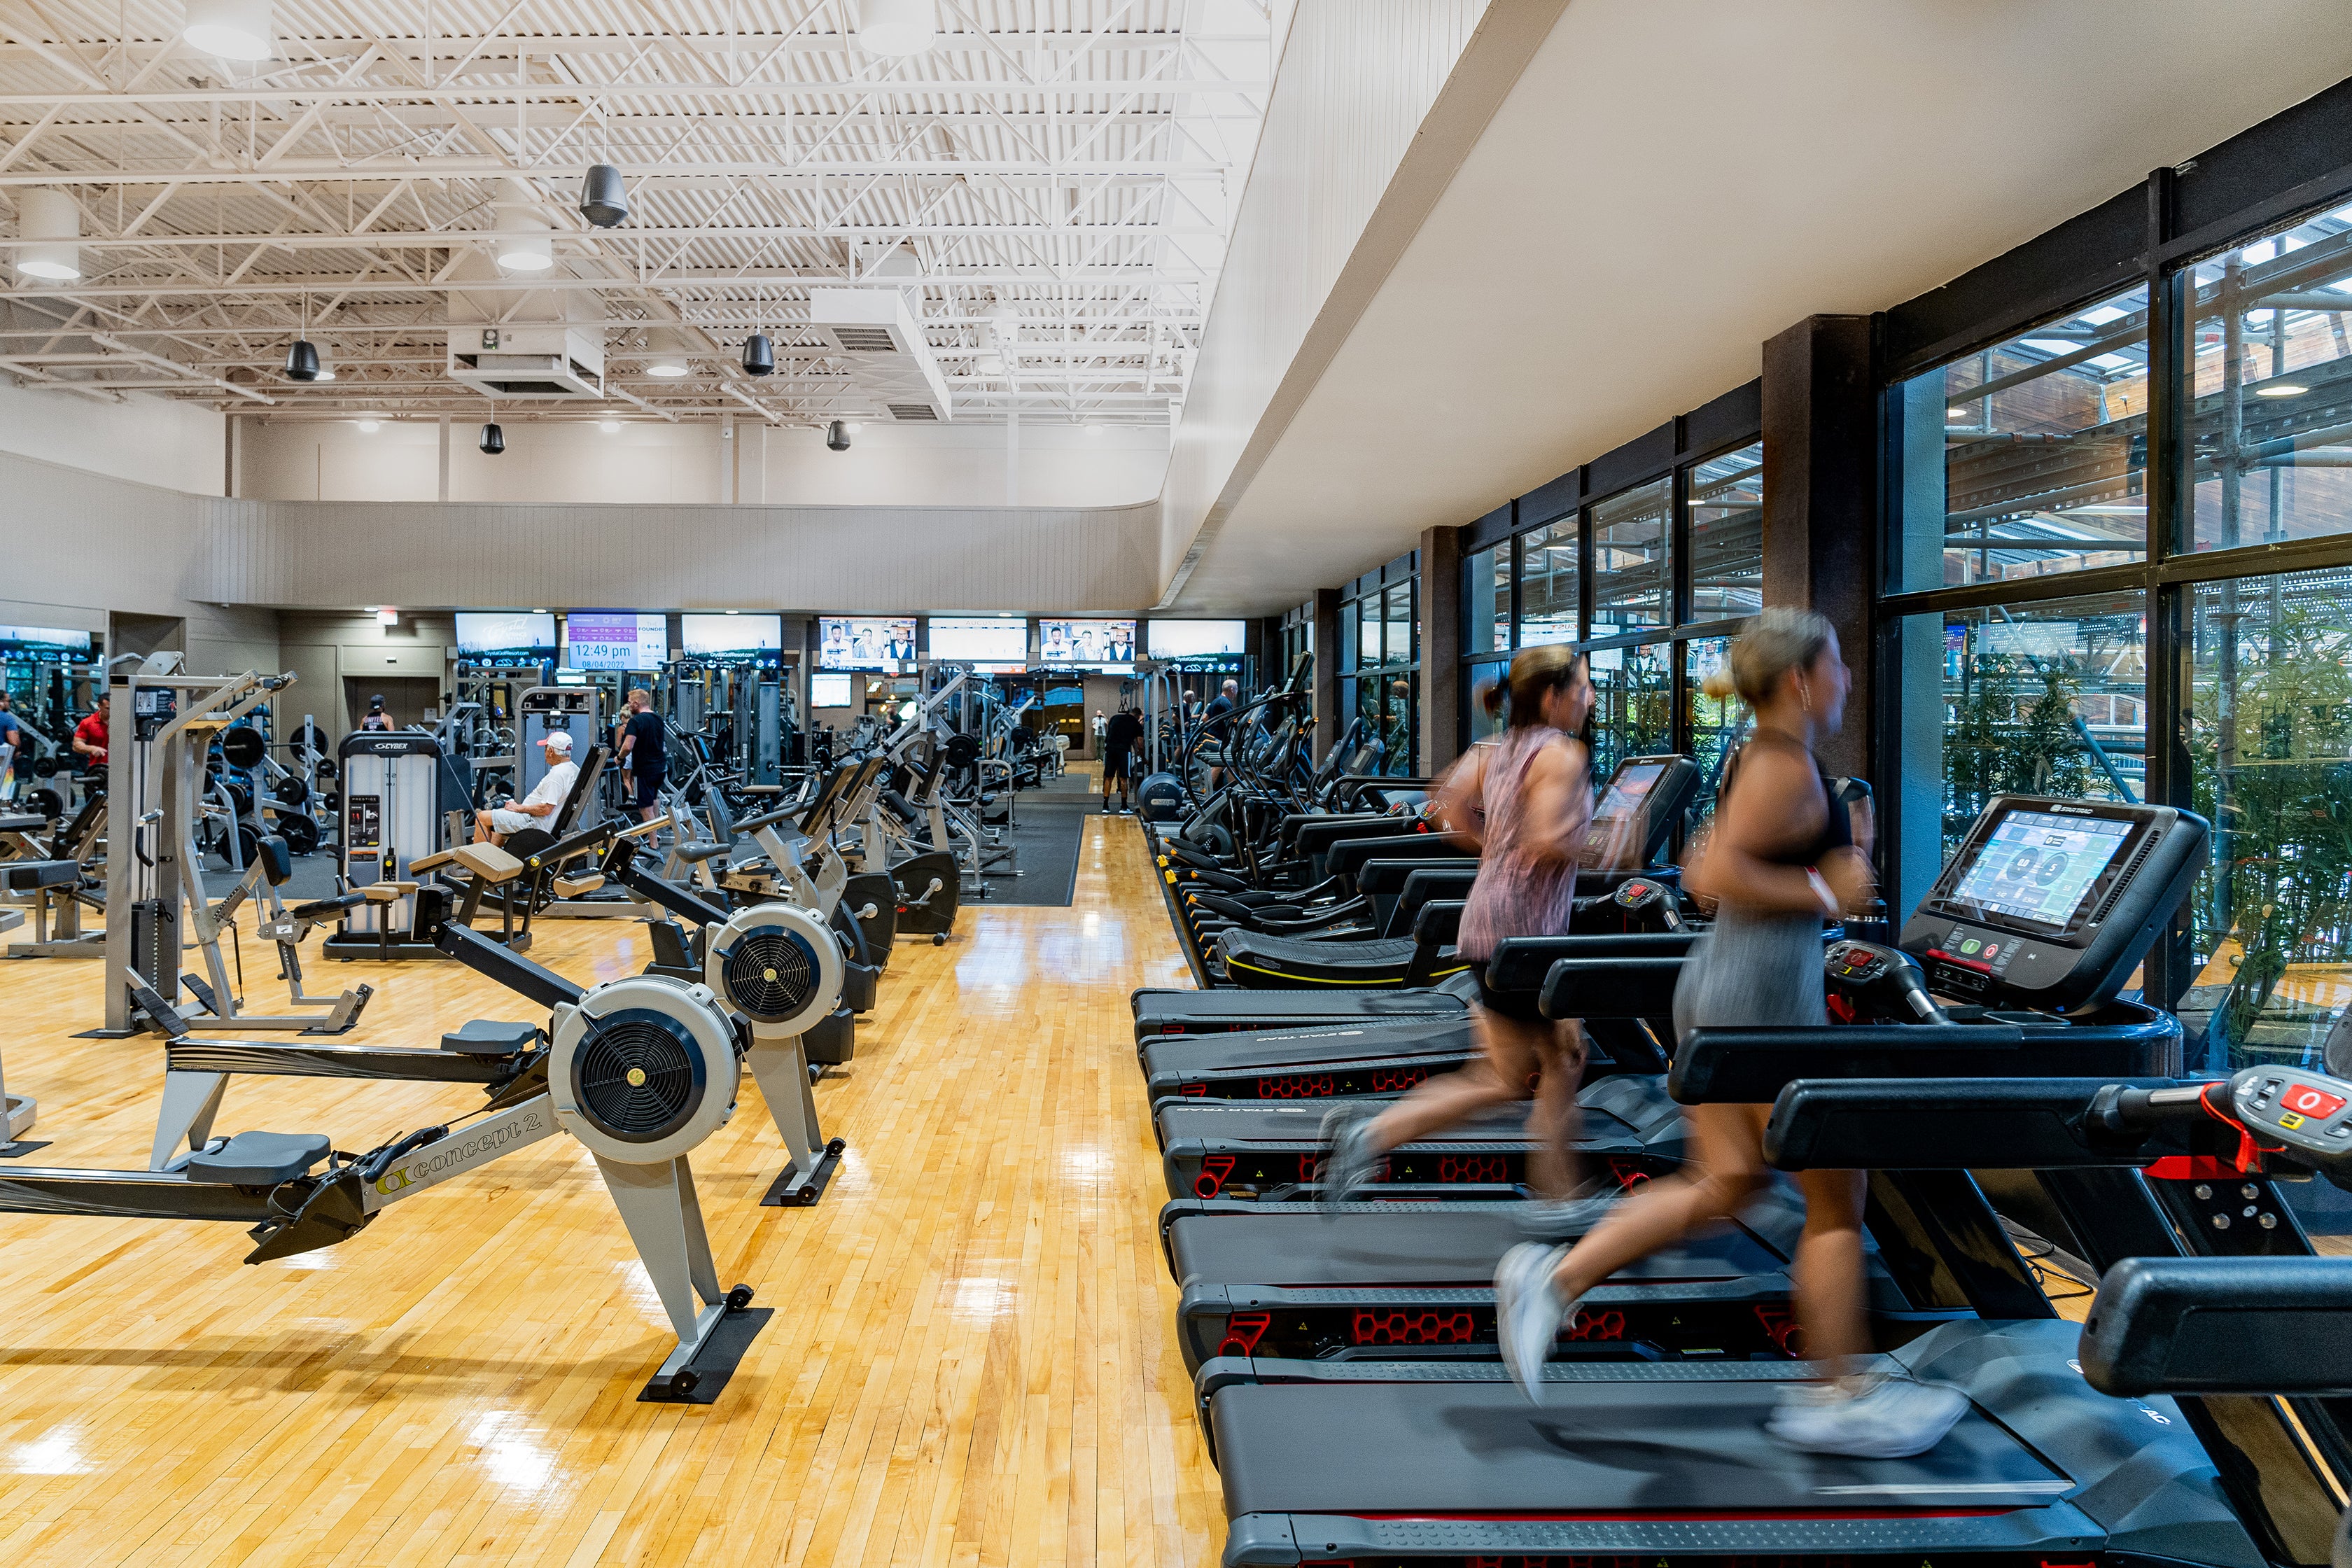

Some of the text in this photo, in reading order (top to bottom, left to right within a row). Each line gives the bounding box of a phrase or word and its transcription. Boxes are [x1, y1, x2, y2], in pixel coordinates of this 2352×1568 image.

[576, 645, 630, 659] 12:49 pm
[582, 660, 624, 668] 08/04/2022
[414, 1113, 542, 1178] concept 2
